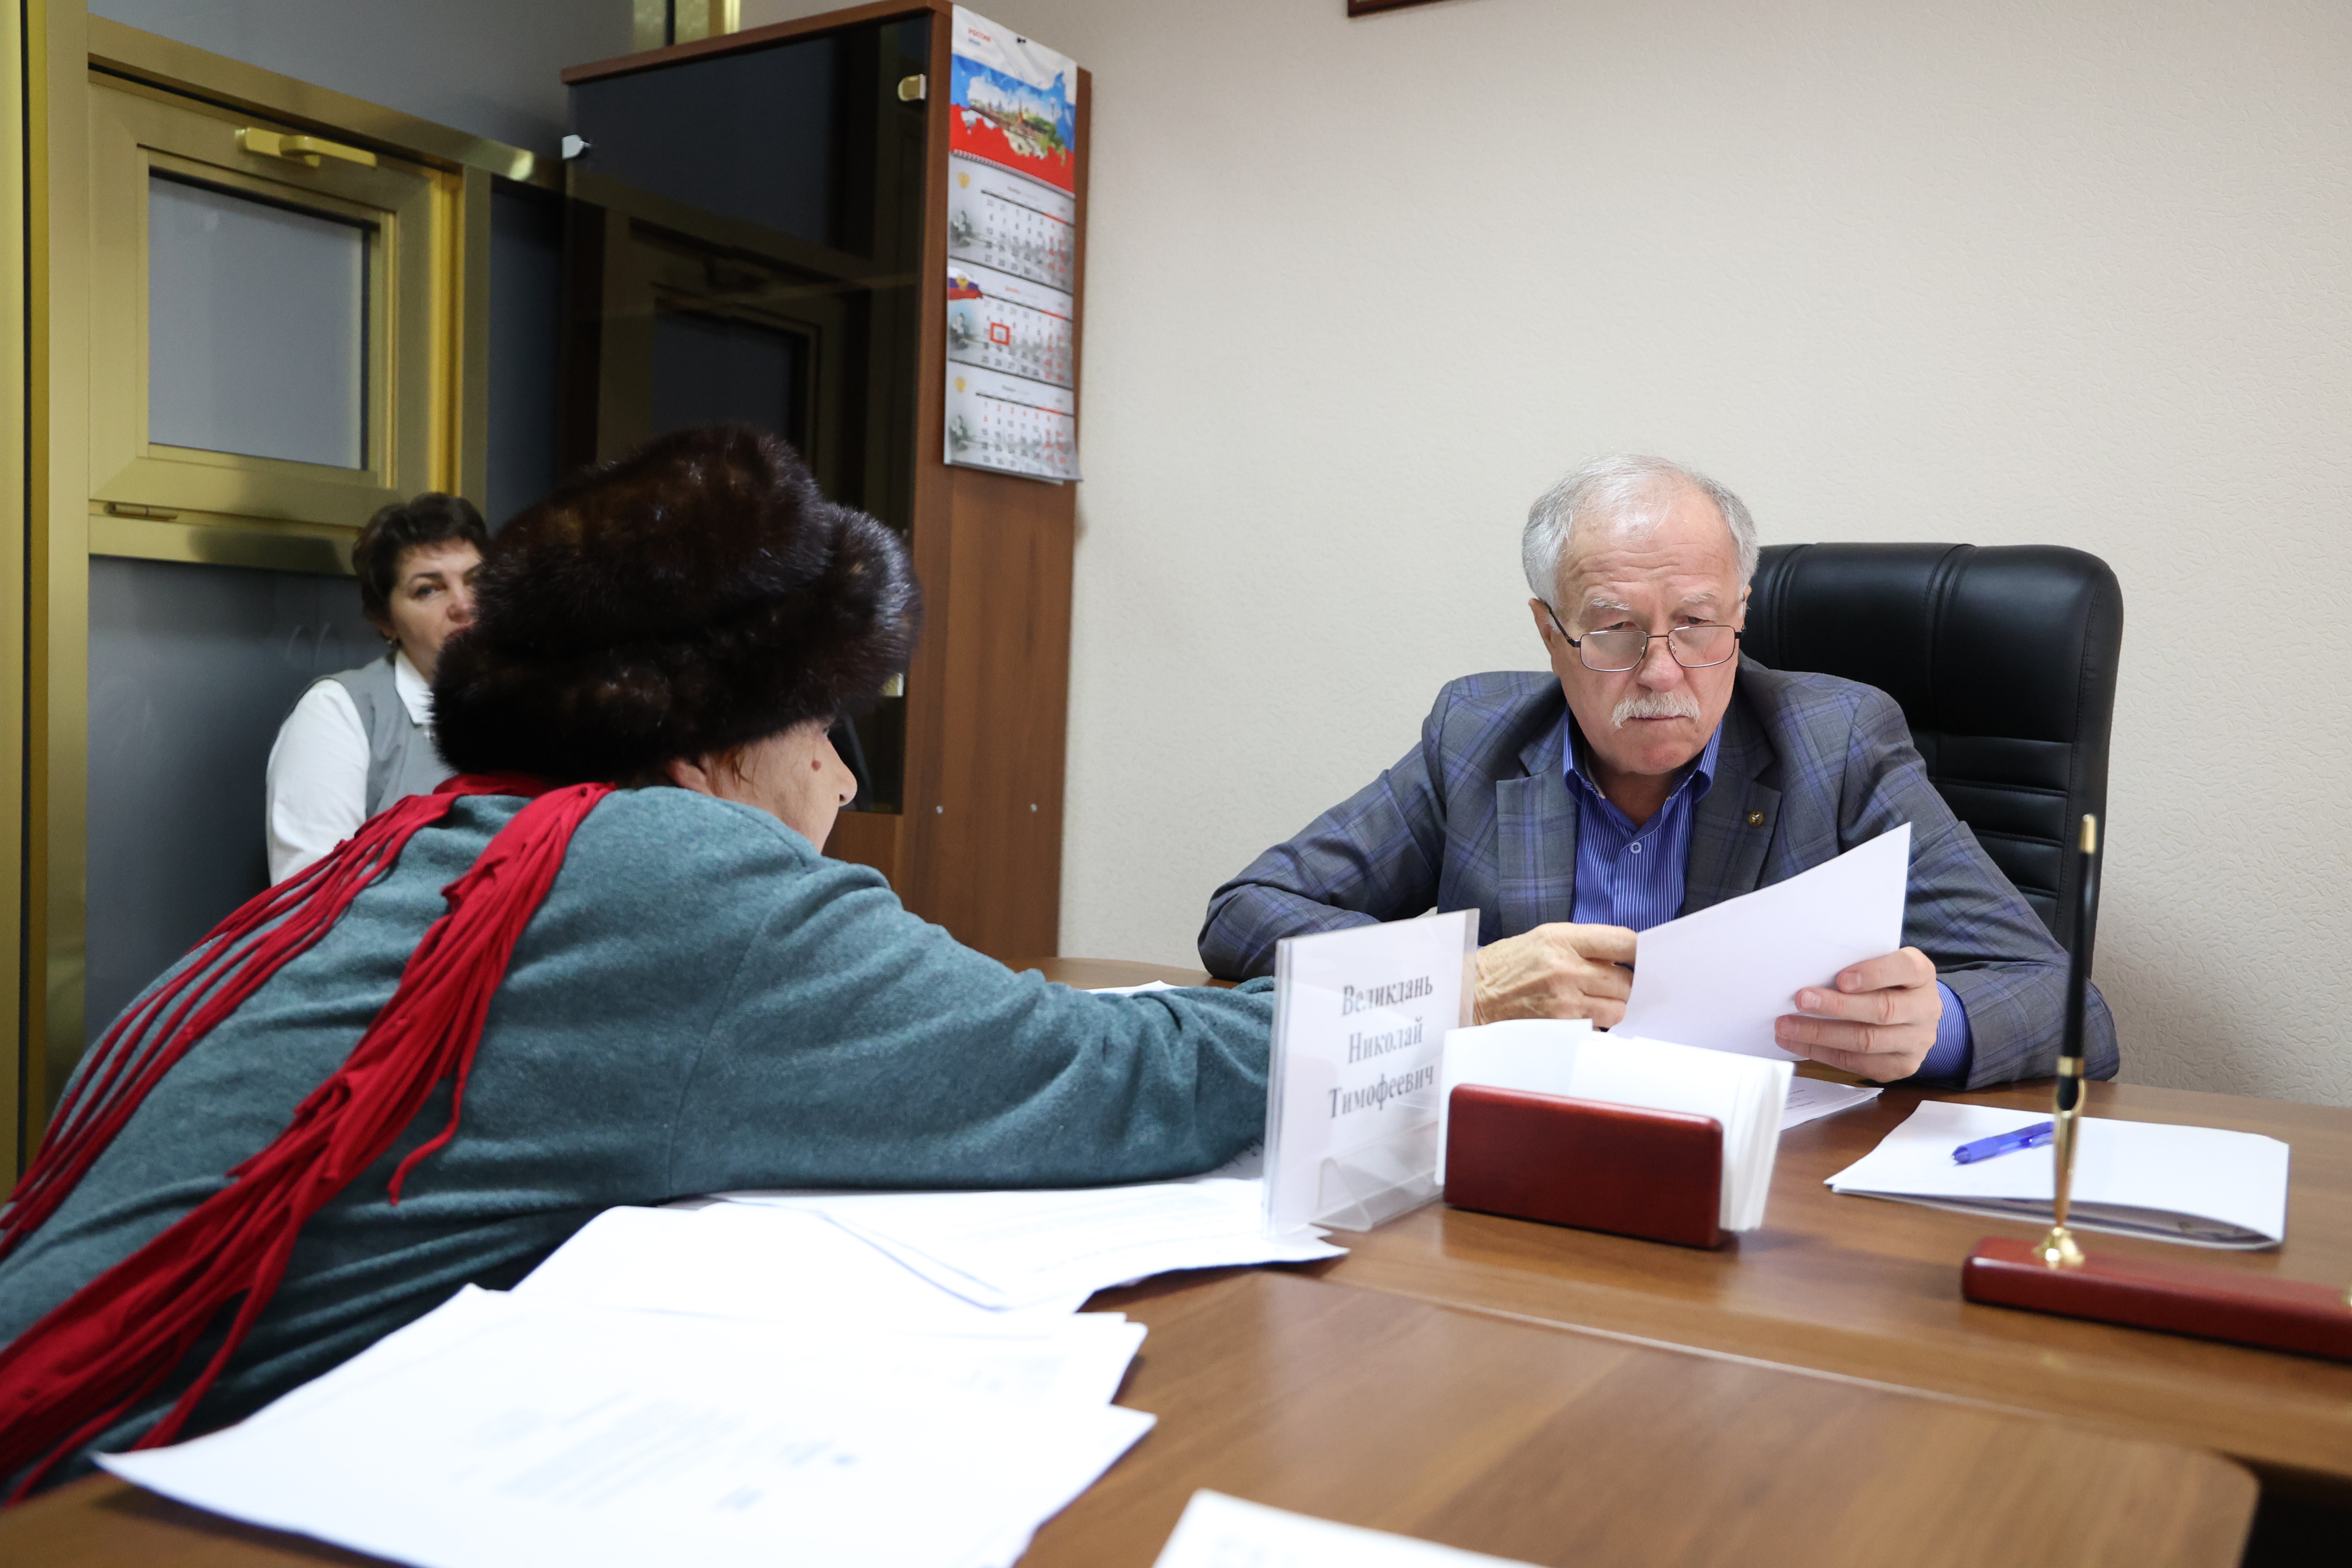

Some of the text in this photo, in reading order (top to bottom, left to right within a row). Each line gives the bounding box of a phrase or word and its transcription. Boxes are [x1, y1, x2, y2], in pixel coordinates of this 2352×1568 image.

[1341, 975, 1433, 1017] Великдань
[1348, 1015, 1423, 1064] Николай
[1328, 1066, 1434, 1118] Тимофеевич
